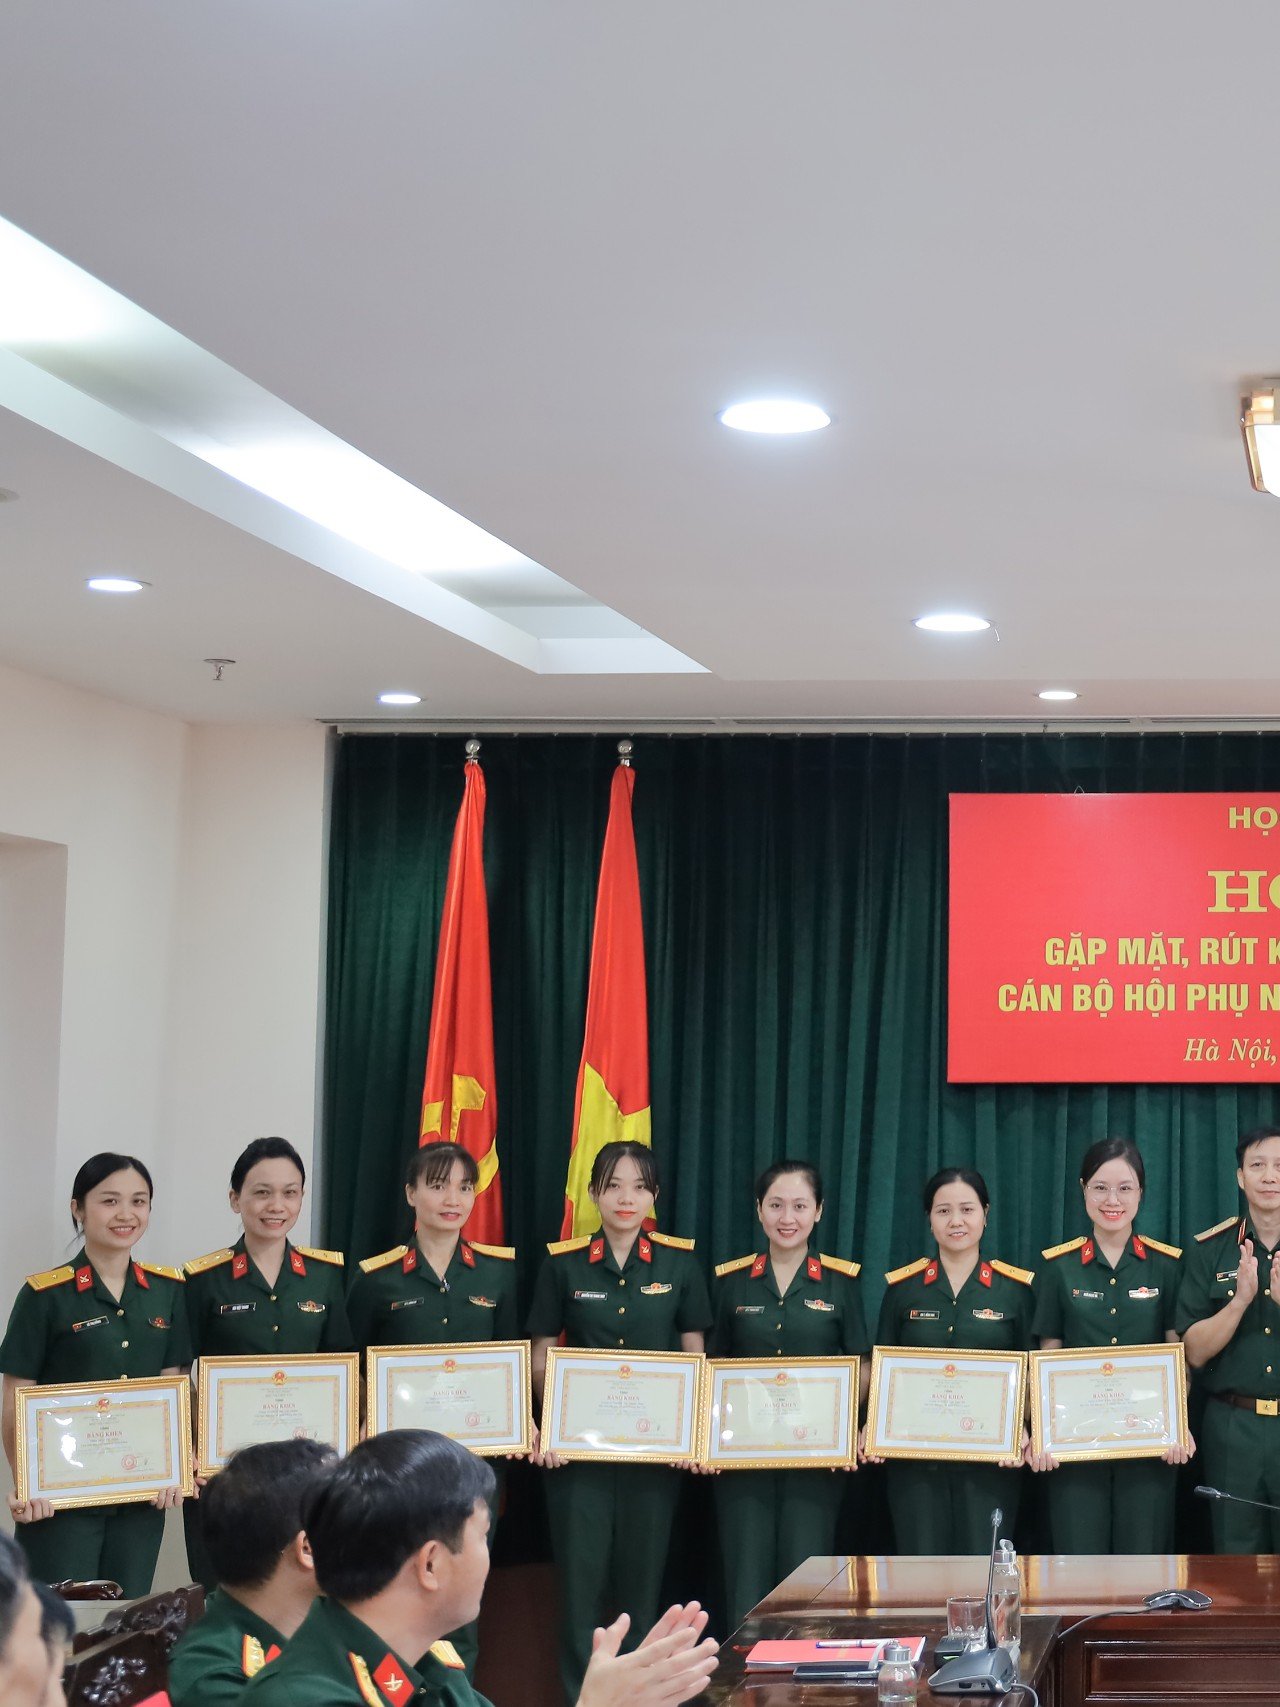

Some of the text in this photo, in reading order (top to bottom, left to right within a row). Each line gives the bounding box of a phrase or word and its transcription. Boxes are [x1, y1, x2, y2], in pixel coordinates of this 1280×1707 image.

[1045, 931, 1107, 972] GẶP
[1117, 931, 1189, 972] MẶT,
[1200, 931, 1259, 966] RÚT
[998, 978, 1062, 1012] CÁN
[1072, 977, 1114, 1018] BỘ
[1124, 977, 1176, 1018] HỘI
[1186, 983, 1249, 1018] PHỤ
[1183, 1038, 1220, 1062] Hà
[1227, 1038, 1277, 1069] Nội,
